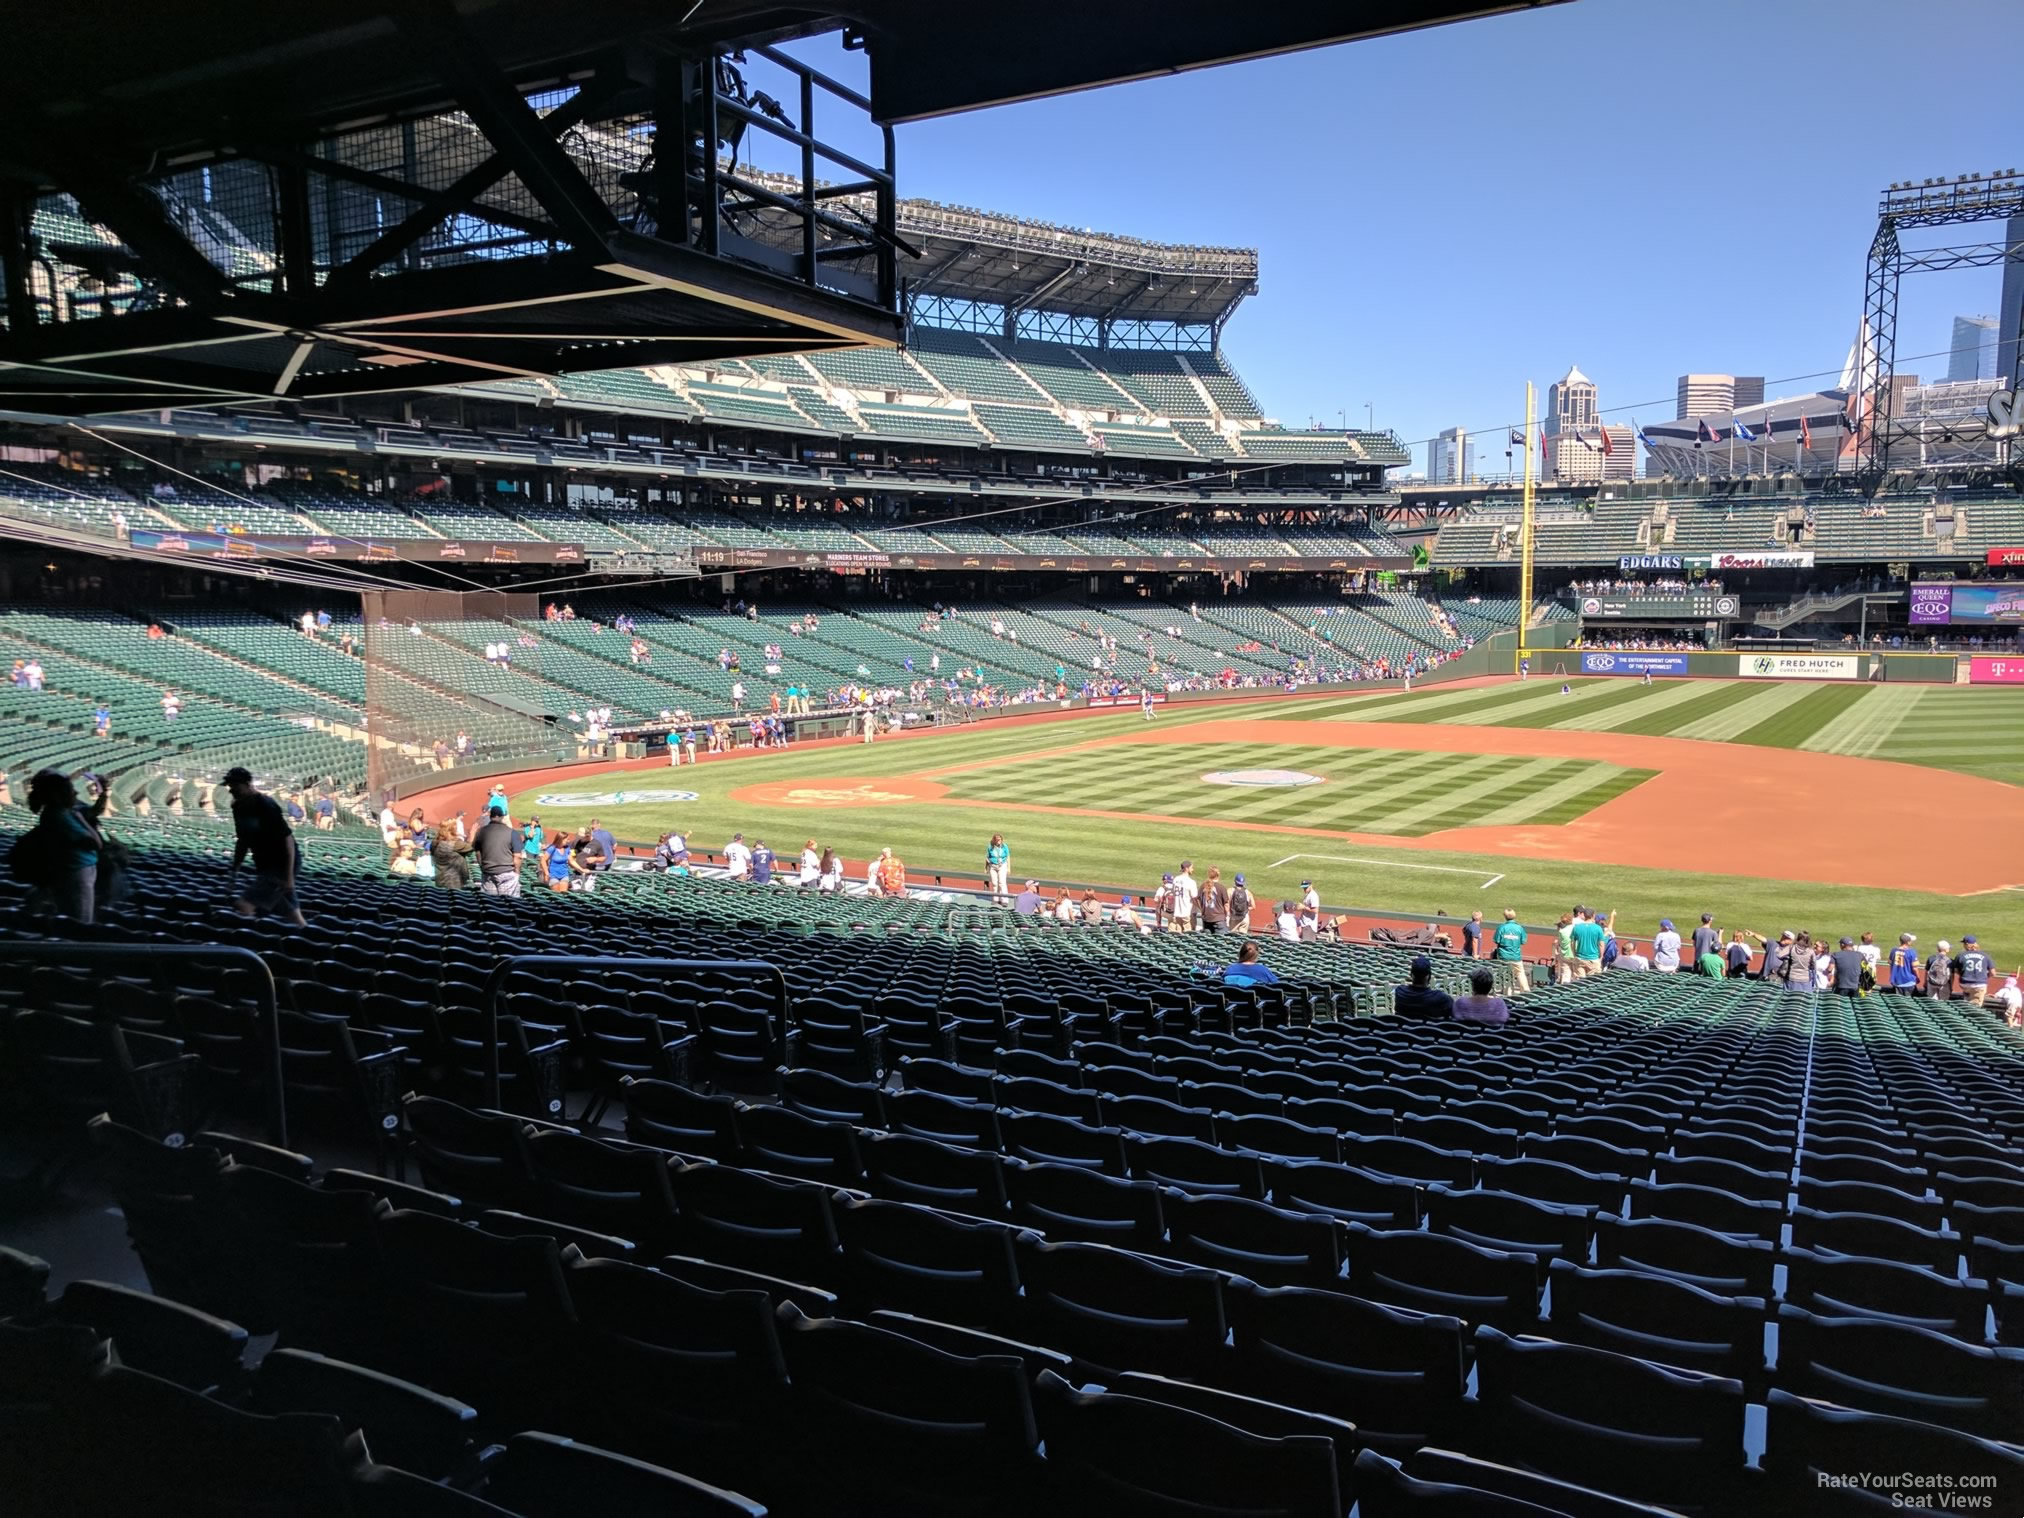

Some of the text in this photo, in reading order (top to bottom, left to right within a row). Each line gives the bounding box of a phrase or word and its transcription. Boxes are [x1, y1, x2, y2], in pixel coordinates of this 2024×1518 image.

[702, 551, 724, 562] 11:19
[1719, 554, 1763, 568] Coors
[1620, 556, 1680, 569] EDGARS
[1918, 594, 1944, 602] QUEEN
[1520, 650, 1531, 658] 331
[1809, 660, 1844, 668] HUTCH
[760, 854, 767, 864] 2
[1965, 959, 1984, 972] 34
